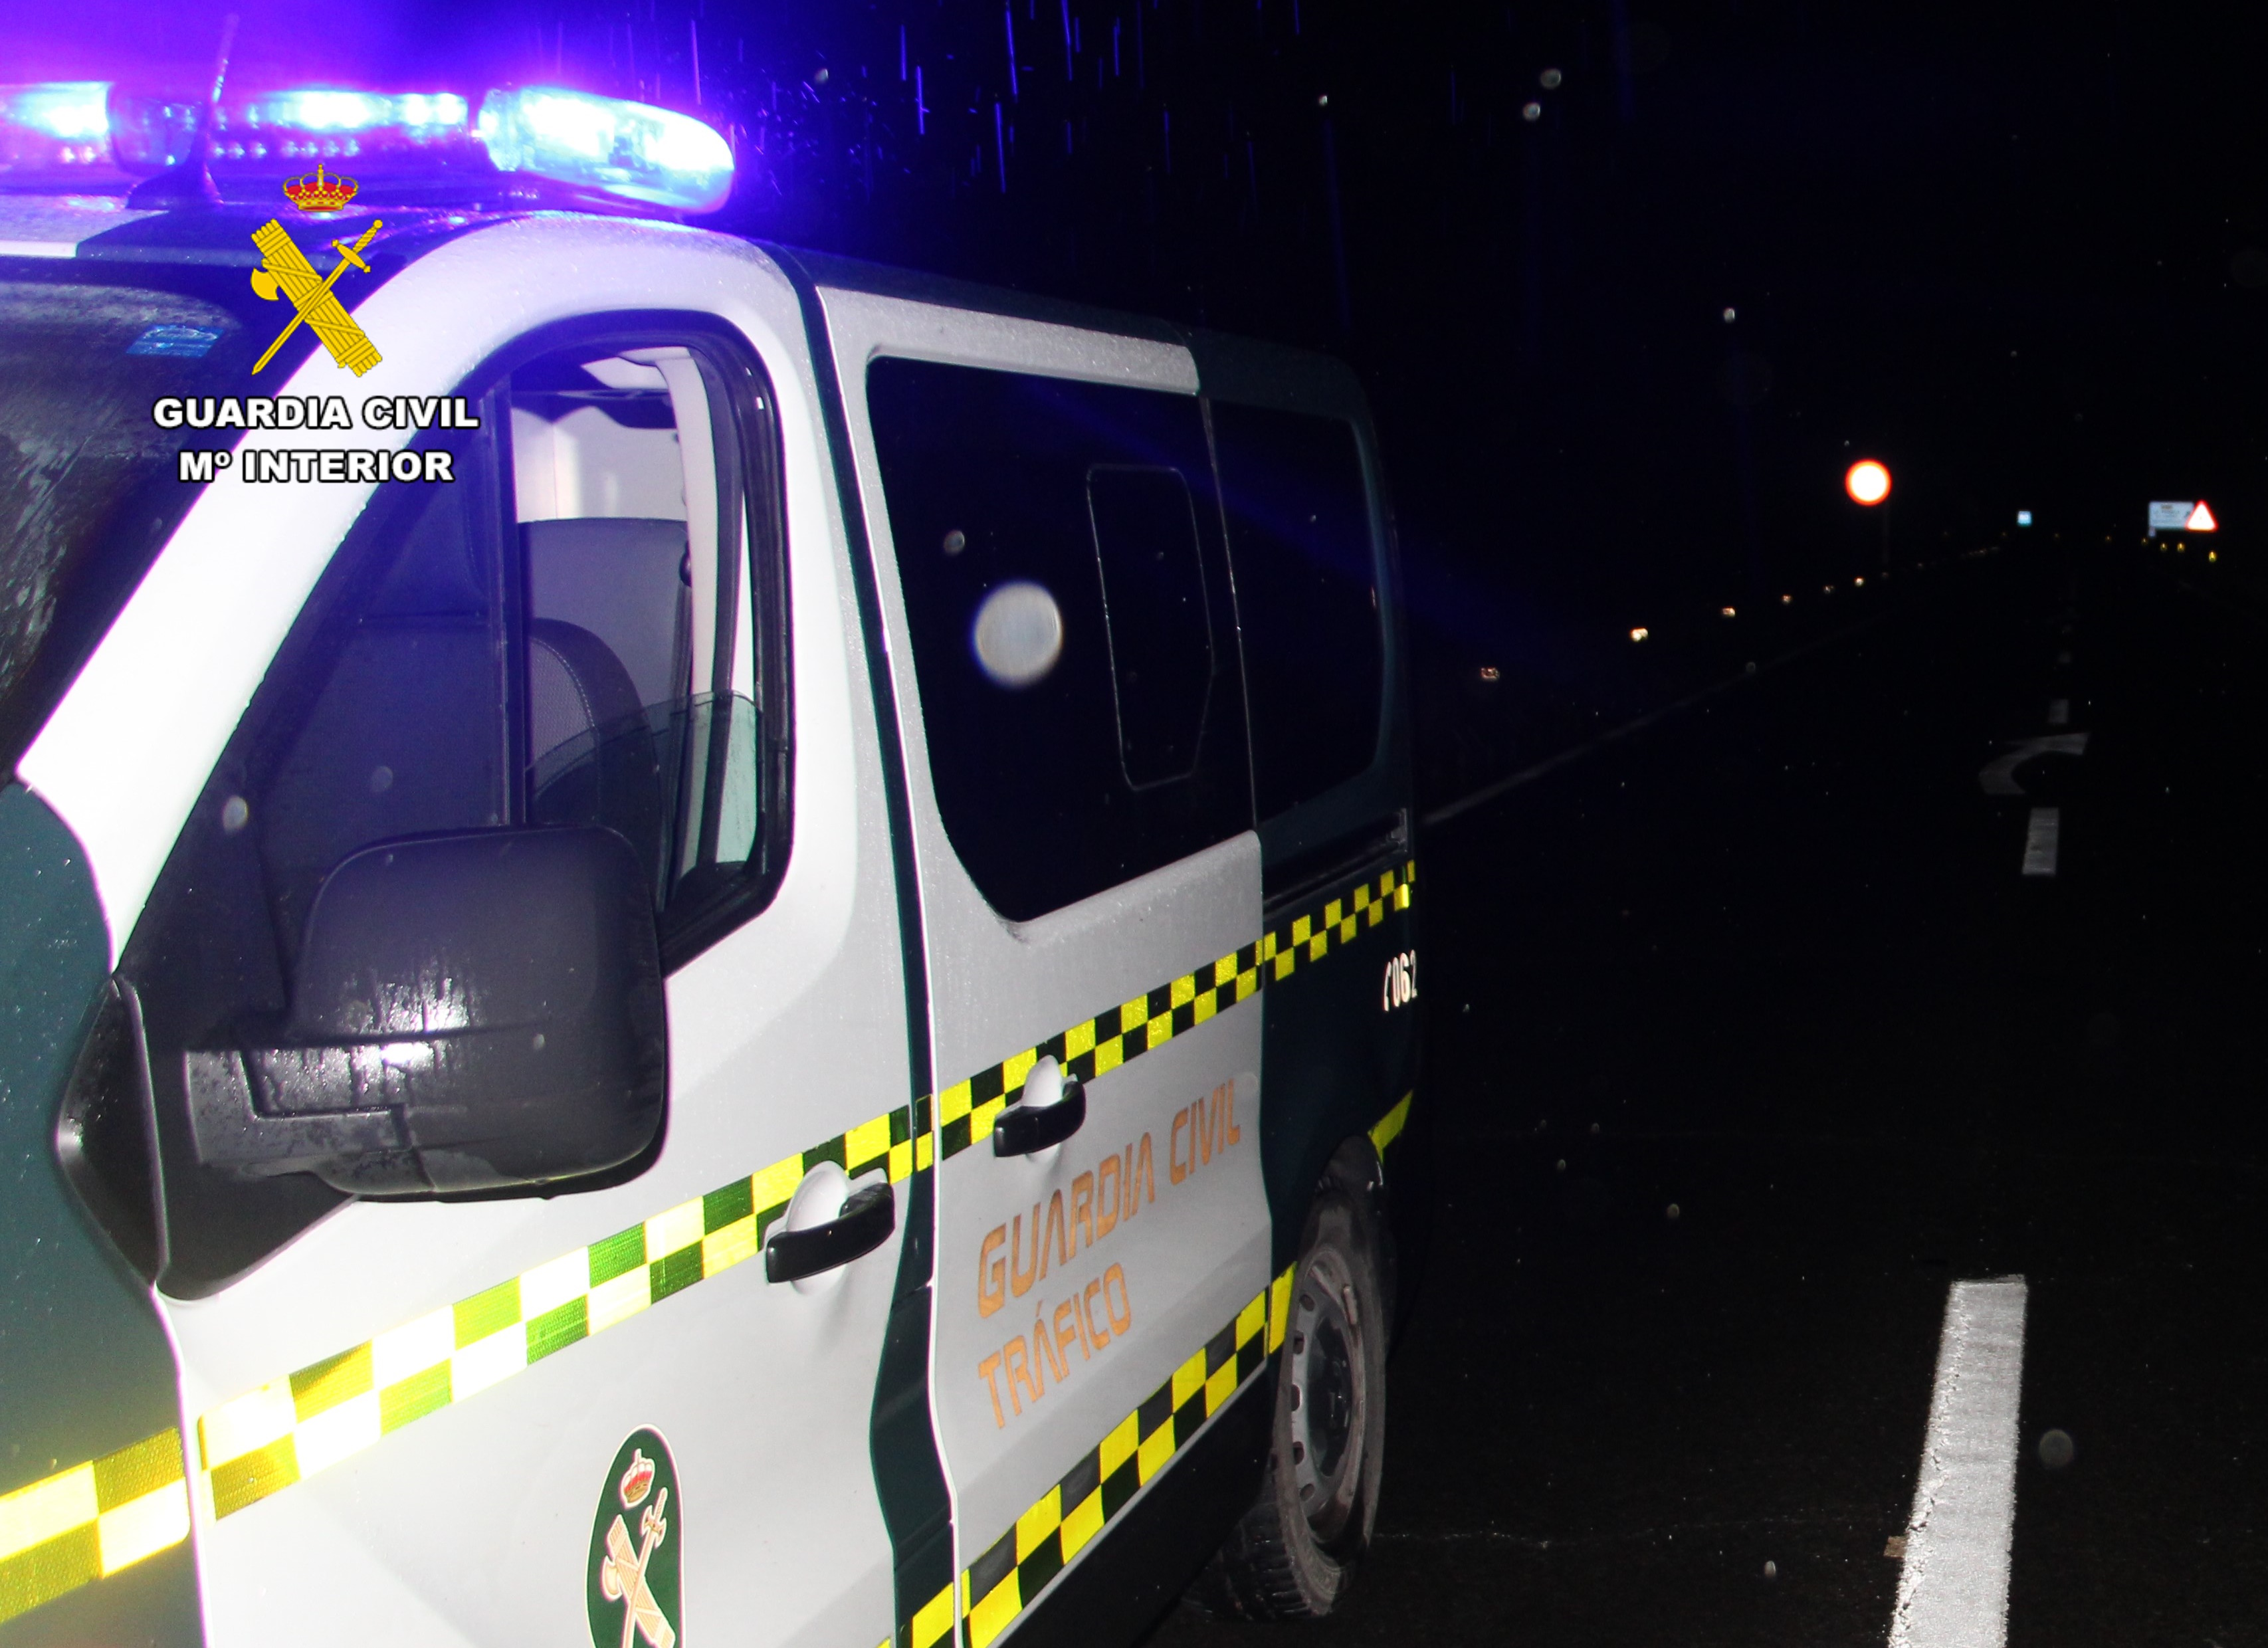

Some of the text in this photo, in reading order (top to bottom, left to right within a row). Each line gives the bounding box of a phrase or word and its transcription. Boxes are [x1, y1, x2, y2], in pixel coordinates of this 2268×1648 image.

[978, 1079, 1241, 1318] GUARDIA CIVIL
[978, 1262, 1132, 1429] TRÁFICO
